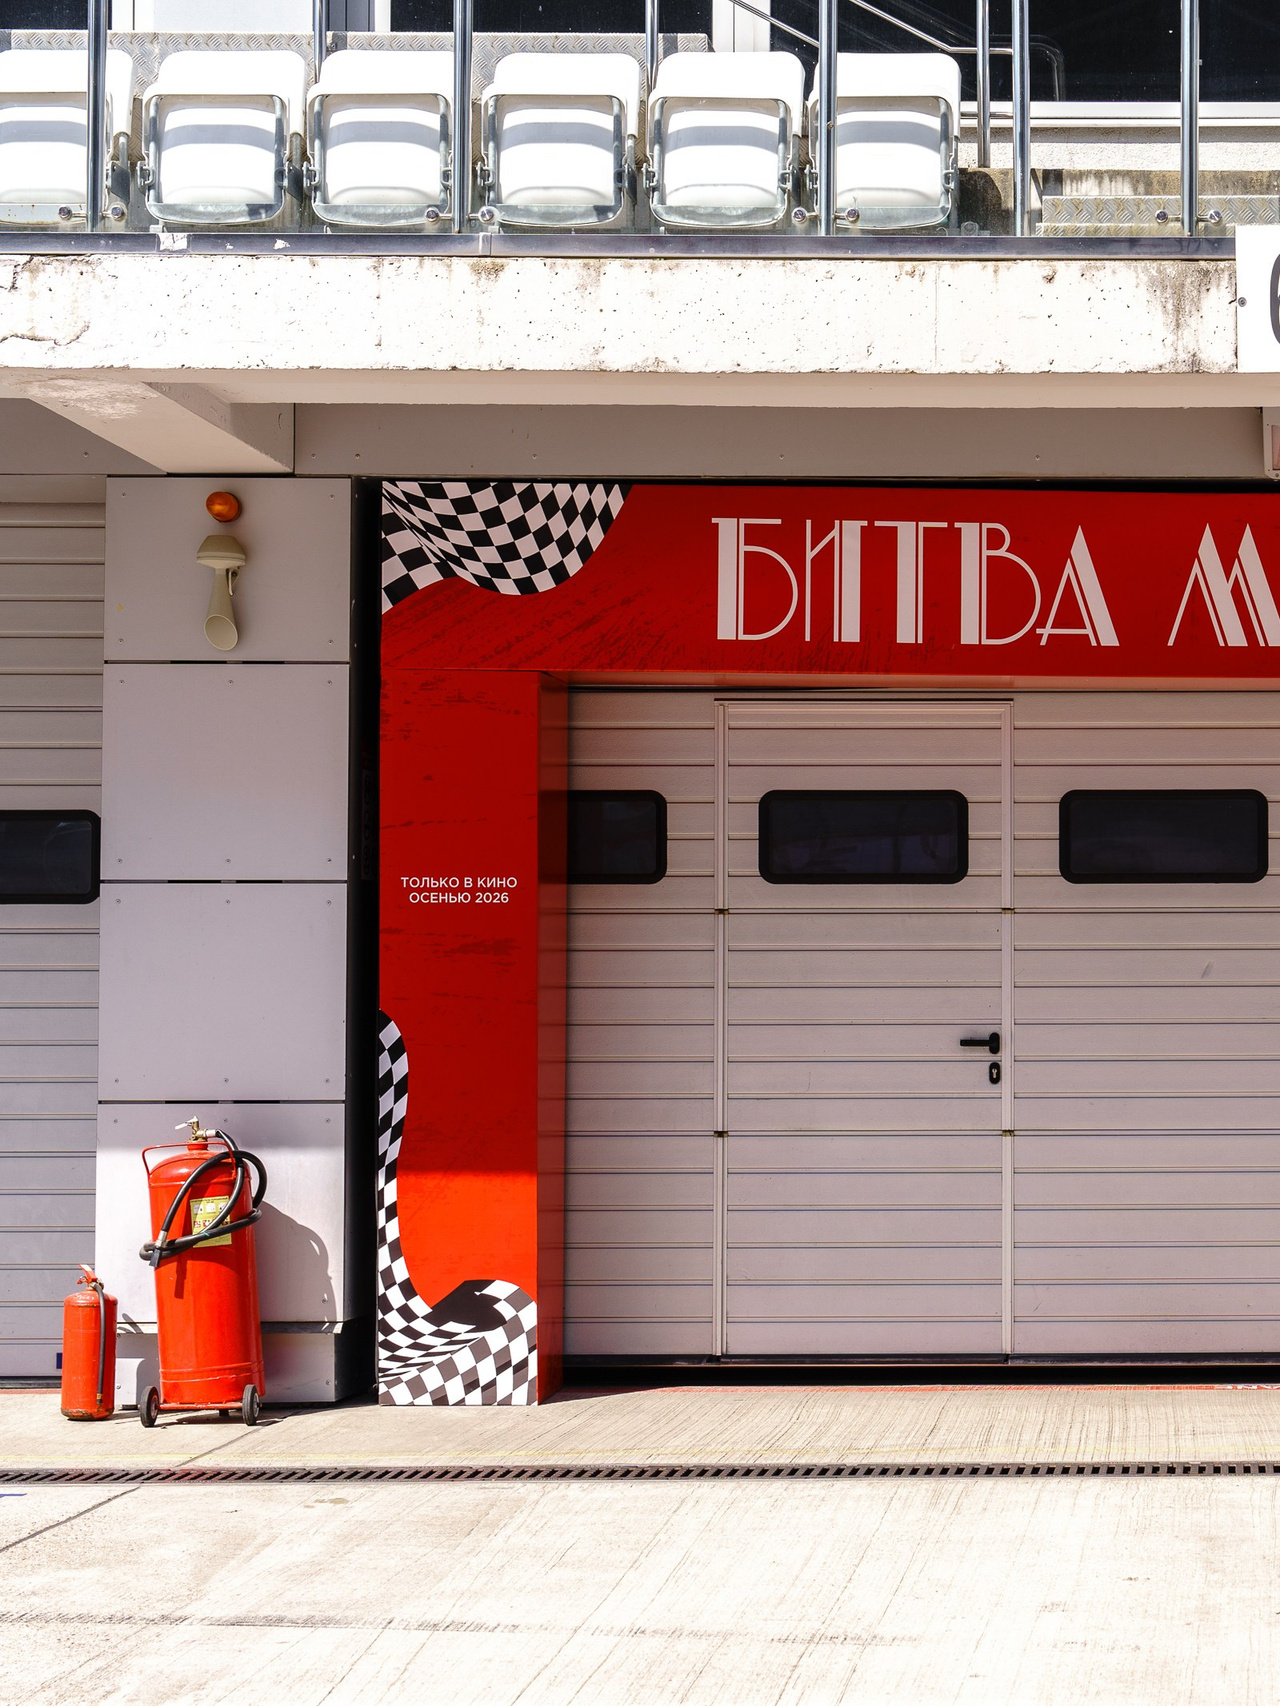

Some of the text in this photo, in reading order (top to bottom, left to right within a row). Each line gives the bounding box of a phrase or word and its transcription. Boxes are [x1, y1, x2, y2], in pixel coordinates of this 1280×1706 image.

[711, 517, 1120, 647] БИТВА
[400, 876, 518, 888] ТОЛЬКО В КИНО
[409, 892, 509, 904] ОСЕНЬЮ 2026
